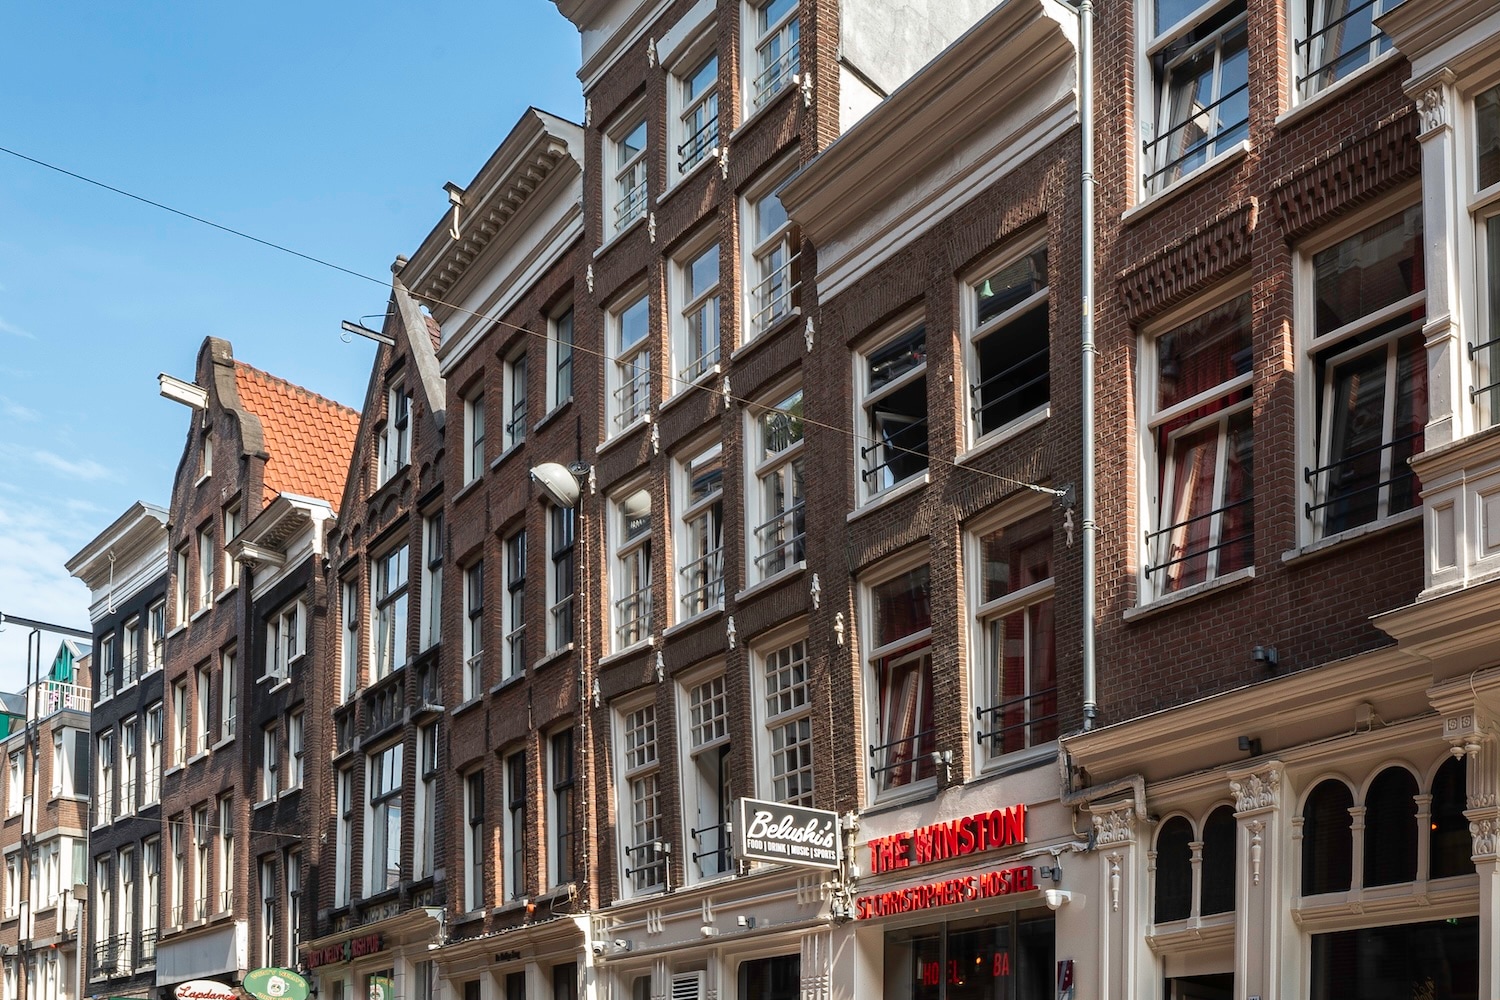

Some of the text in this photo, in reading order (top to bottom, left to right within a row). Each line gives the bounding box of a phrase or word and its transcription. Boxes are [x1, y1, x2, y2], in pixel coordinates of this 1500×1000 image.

[747, 811, 835, 848] Belushi's
[867, 803, 1028, 874] THE WINSTON
[747, 839, 836, 860] FOOD DRINK MUSIC SPORTS
[979, 865, 1039, 899] HOSTEL
[923, 960, 960, 985] HOEL
